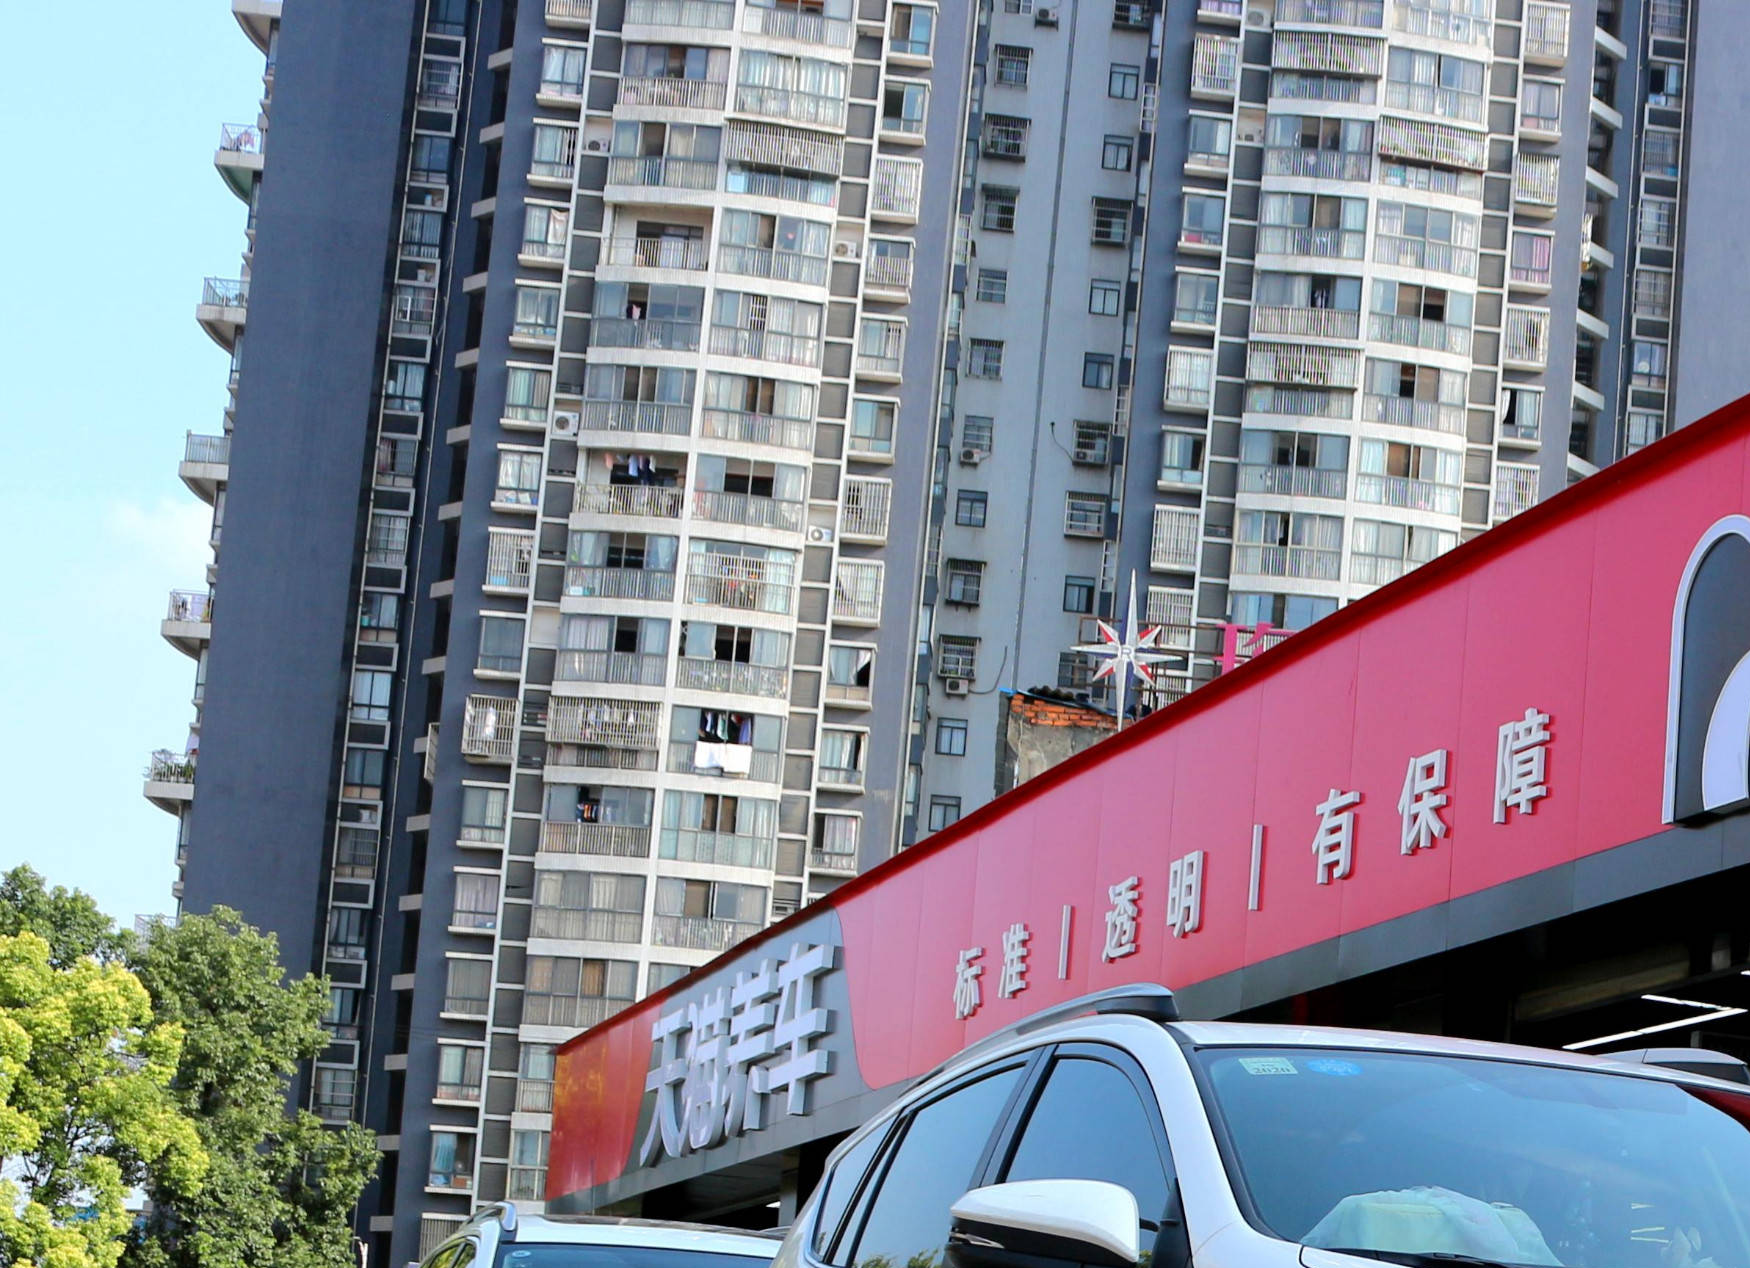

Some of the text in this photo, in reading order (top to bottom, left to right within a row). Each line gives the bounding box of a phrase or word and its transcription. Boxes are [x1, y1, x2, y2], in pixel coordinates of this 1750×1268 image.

[954, 707, 1555, 1020] 标准 透明 有保障
[639, 942, 836, 1168] 天猫养车
